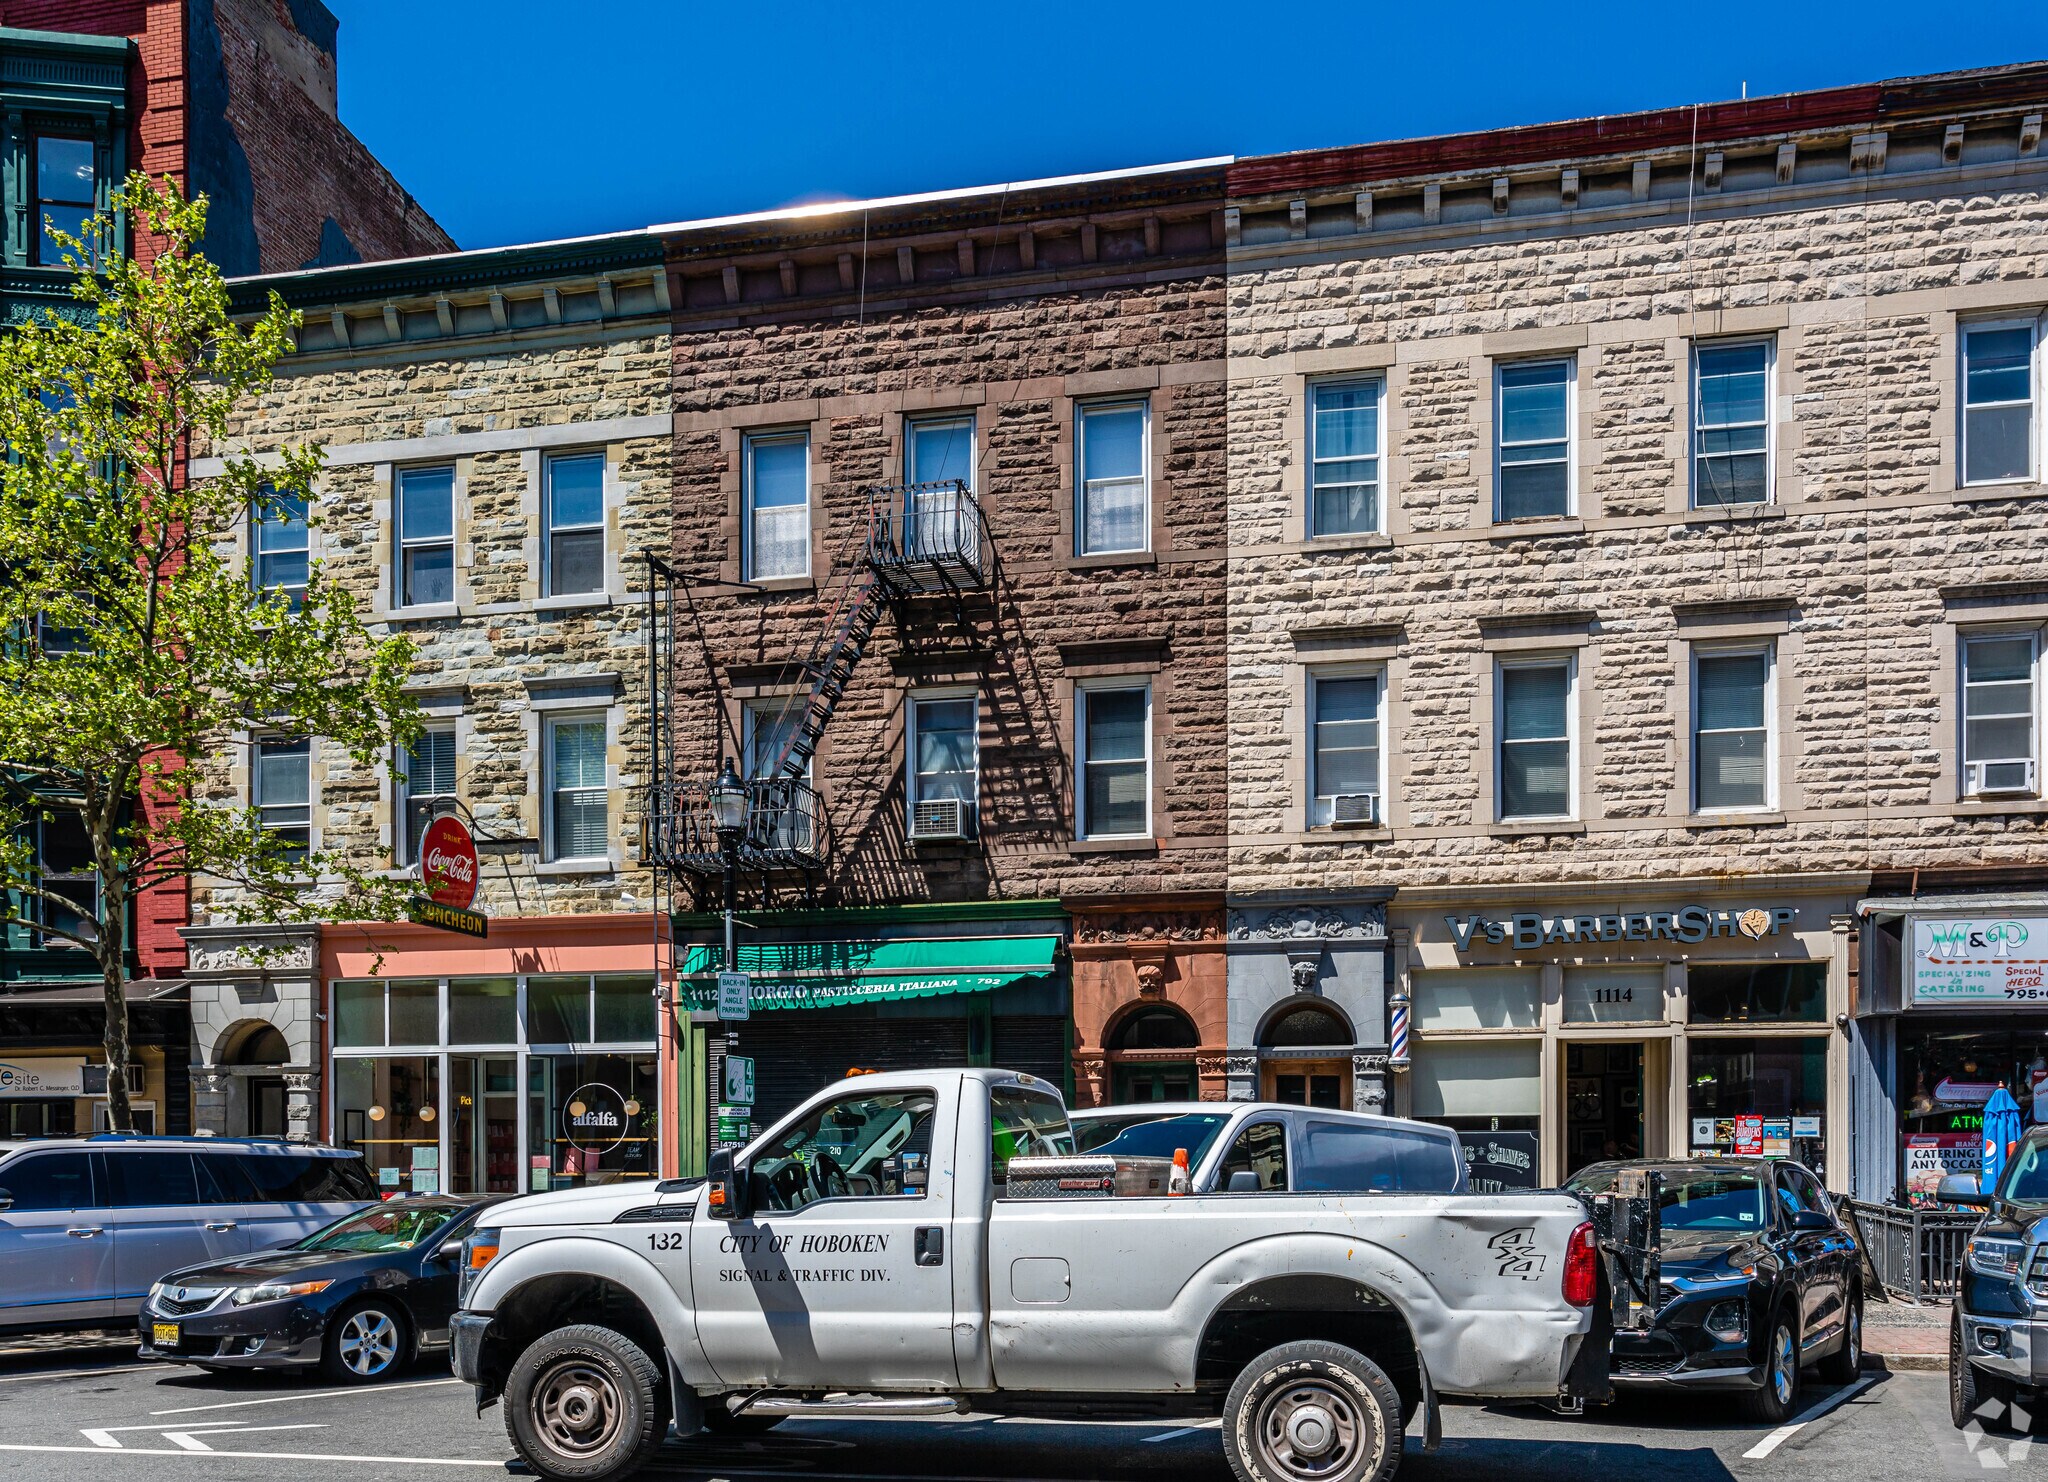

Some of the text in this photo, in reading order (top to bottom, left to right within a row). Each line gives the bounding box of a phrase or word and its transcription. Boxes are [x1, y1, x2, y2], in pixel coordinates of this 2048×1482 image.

[443, 832, 461, 844] DRINK
[1918, 970, 1991, 978] SPECIALIZING
[722, 979, 746, 987] BACK-IN
[1919, 985, 1985, 993] CATERING
[749, 985, 807, 1000] IORGIO
[898, 980, 958, 992] ITALIANA
[1594, 988, 1633, 1003] 1114
[746, 1061, 753, 1080] 4
[0, 1069, 40, 1086] esite
[460, 1096, 472, 1105] Pick
[572, 1112, 618, 1127] alfalfa
[1951, 1115, 1983, 1128] ATM
[1914, 1150, 1976, 1159] CATERING
[1911, 1160, 1983, 1170] ANY OCCAS
[648, 1232, 683, 1250] 132
[719, 1234, 890, 1253] CITY OF HOBOKEN
[719, 1269, 891, 1282] SIGNAL & TRAFFIC DIV.
[532, 1347, 624, 1379] WRANGLER
